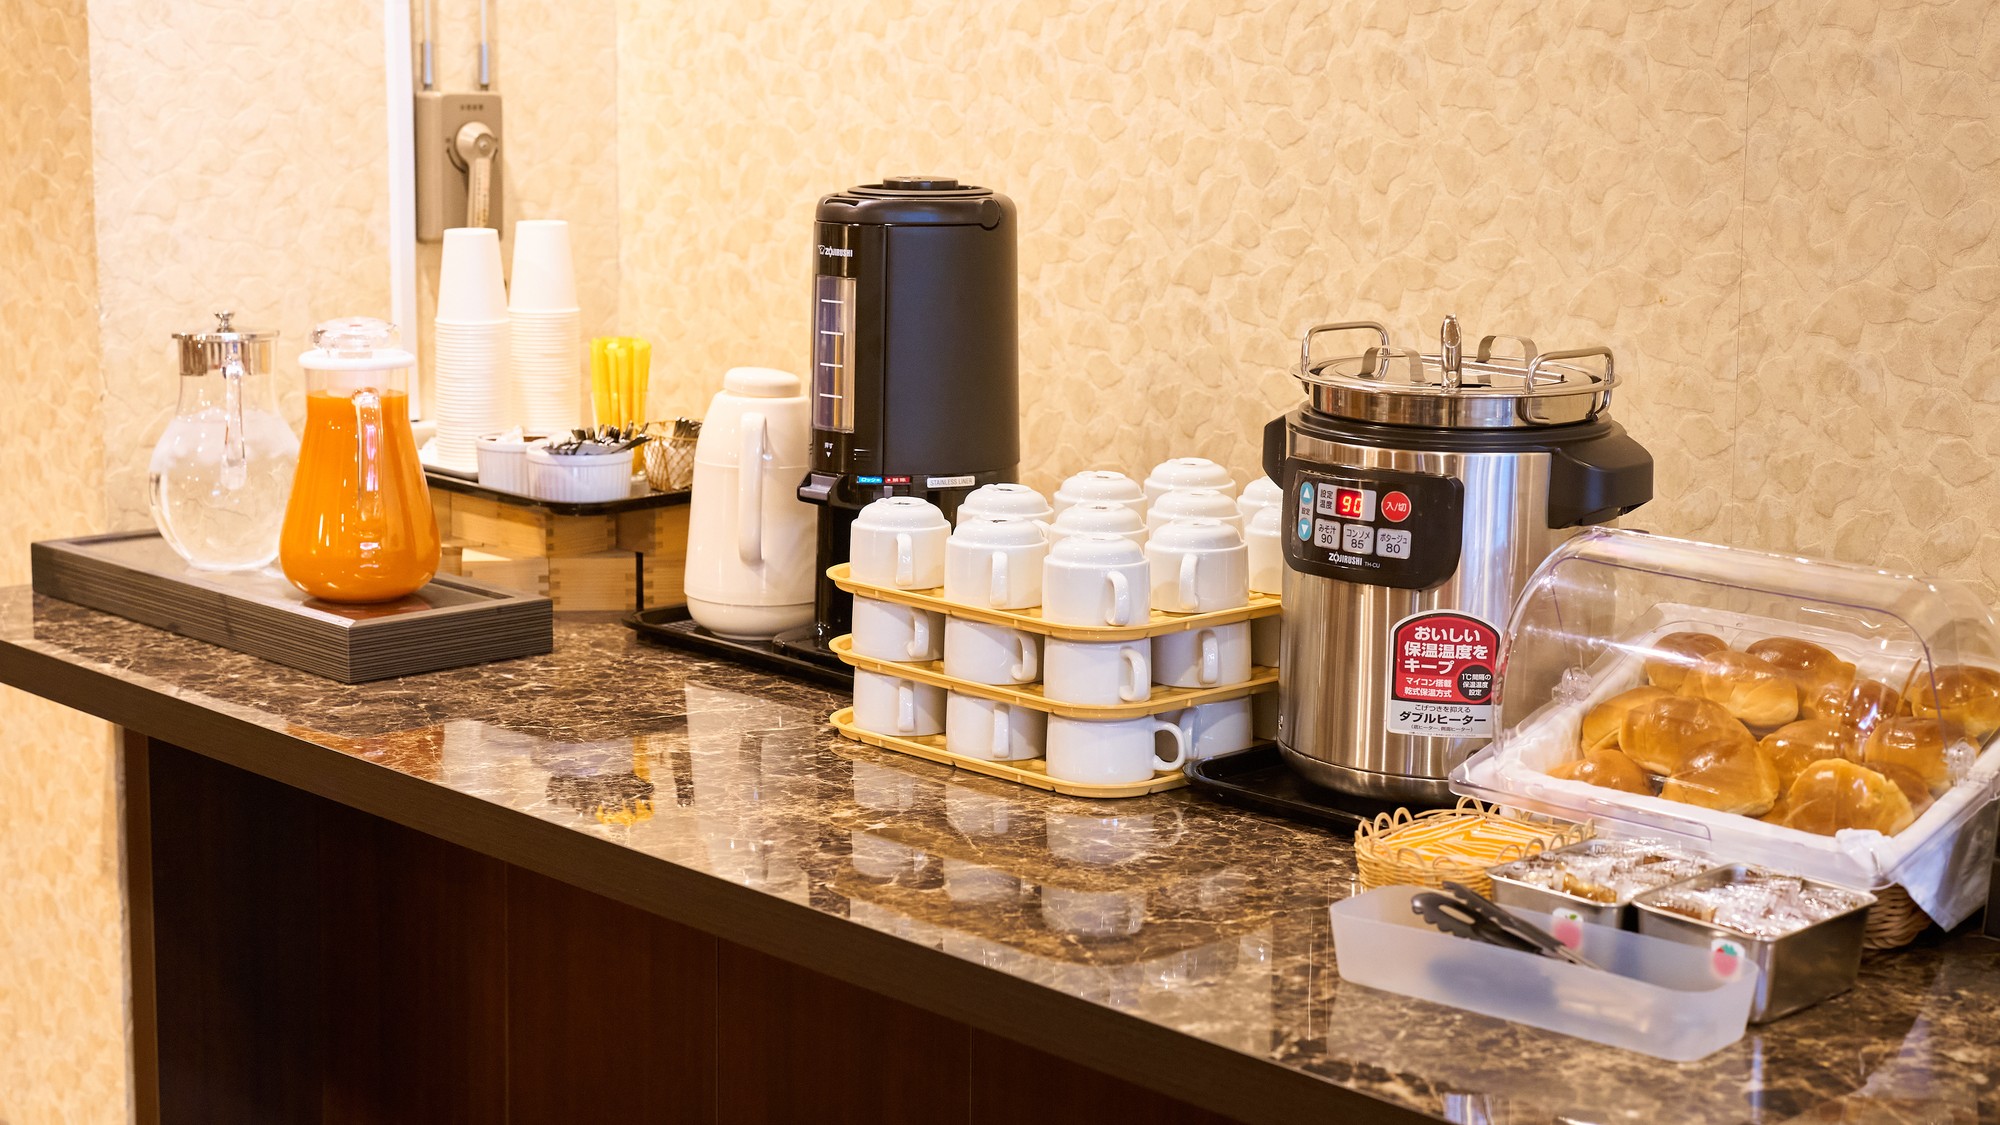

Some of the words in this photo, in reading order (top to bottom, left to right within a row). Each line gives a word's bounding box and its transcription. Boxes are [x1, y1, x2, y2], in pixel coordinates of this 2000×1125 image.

[930, 479, 957, 487] STAINLESS
[1342, 495, 1362, 514] 90
[1386, 501, 1407, 512] 入/切
[1318, 523, 1337, 535] みそ汁
[1346, 528, 1371, 540] コンソメ
[1321, 533, 1333, 545] 90
[1350, 538, 1365, 550] 85
[1380, 533, 1408, 545] ポタージュ
[1385, 543, 1401, 554] 80
[1328, 551, 1363, 566] ZOJIRUSHI
[1414, 626, 1481, 643] おいしい
[1404, 641, 1489, 660] 保温温度を
[1404, 658, 1455, 675] キープ
[1405, 677, 1452, 688] マイコン搭載
[1404, 686, 1452, 698] 乾式保温方式
[1414, 704, 1471, 713] こげつきを抑える
[1399, 711, 1487, 726] ダブルヒーター
